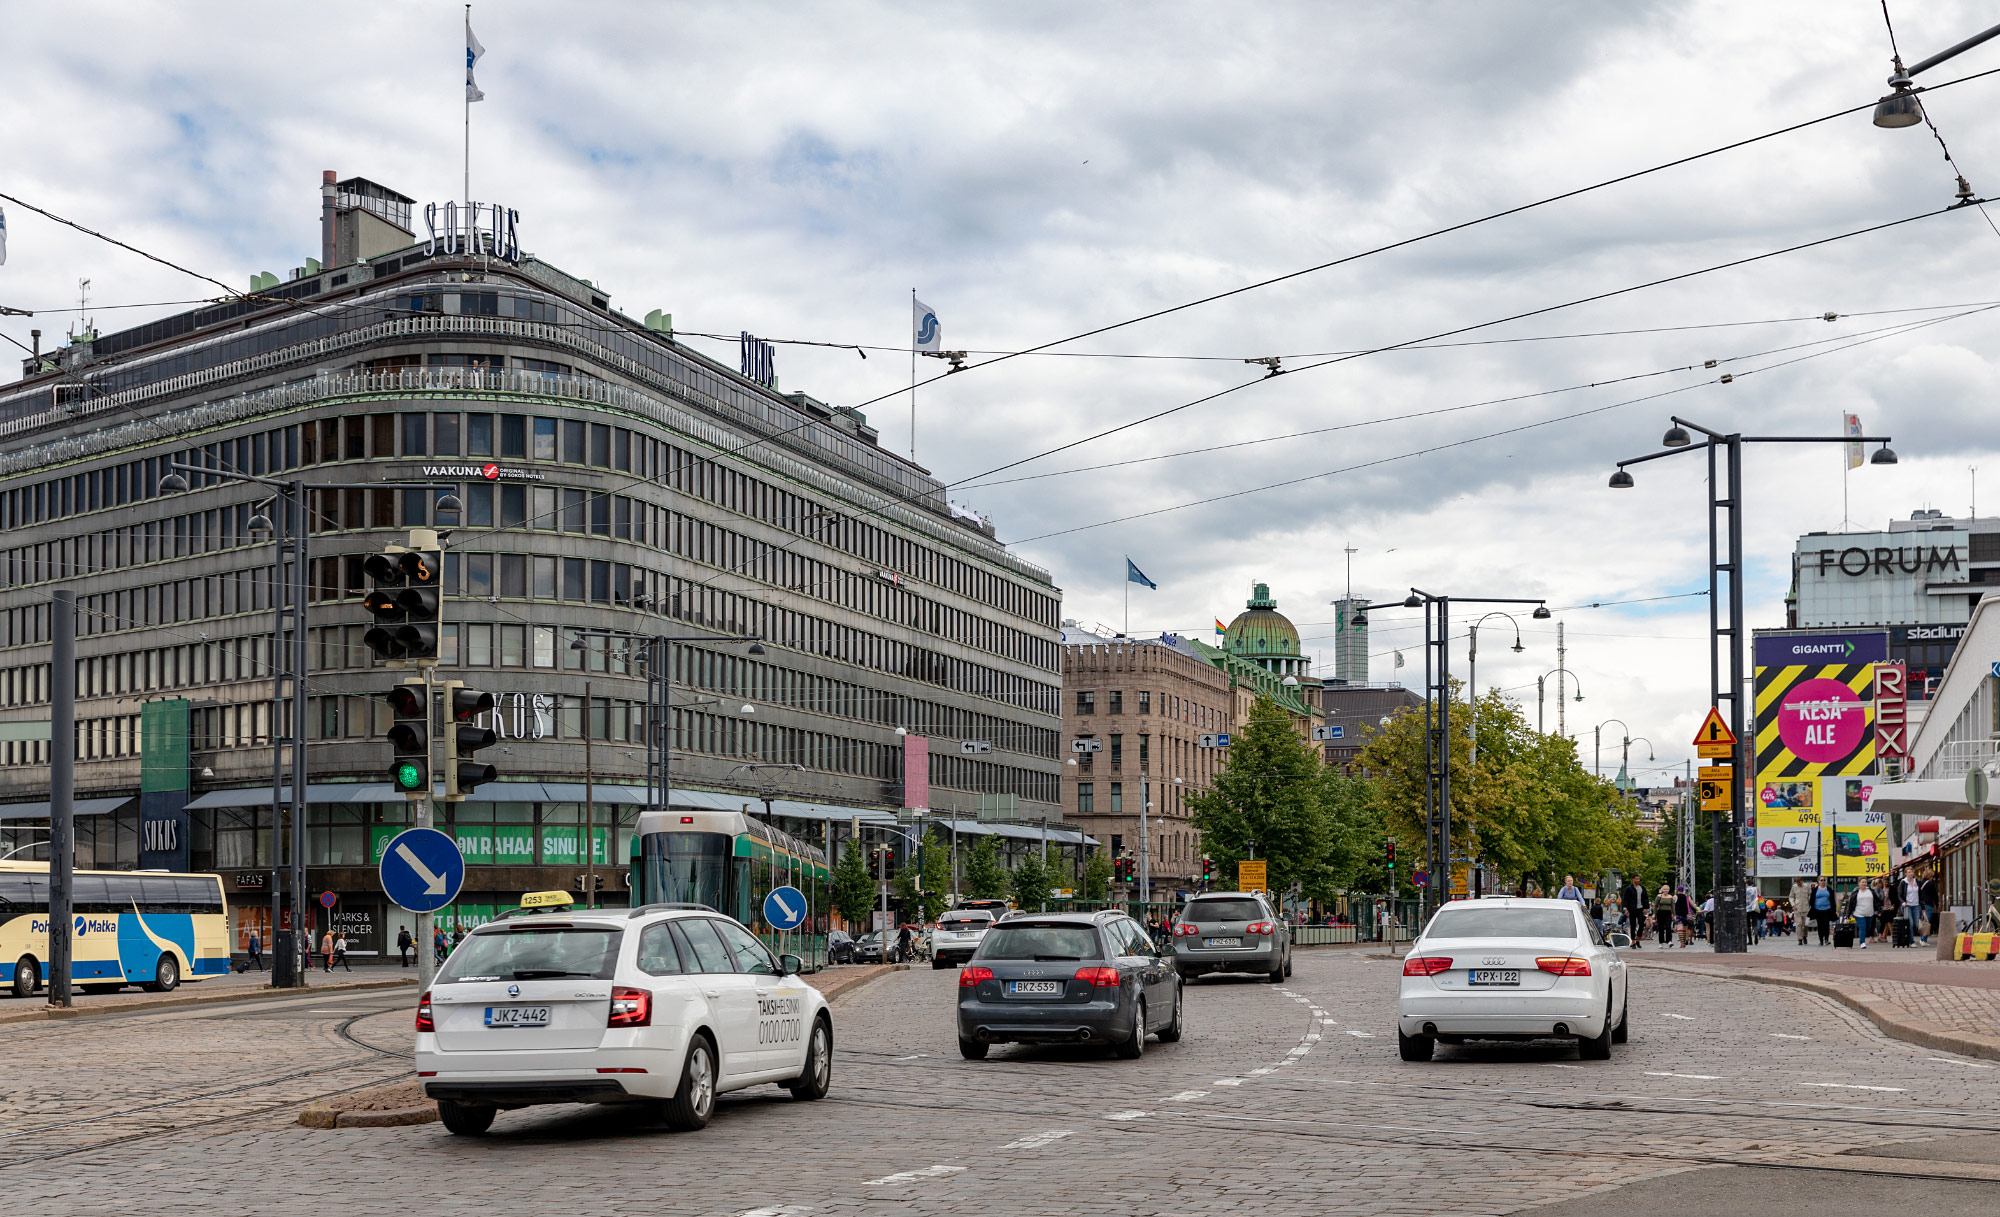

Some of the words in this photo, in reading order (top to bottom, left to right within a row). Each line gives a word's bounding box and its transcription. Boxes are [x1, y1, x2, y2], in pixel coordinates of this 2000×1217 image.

[423, 200, 521, 262] SOKOS
[741, 331, 775, 388] SOKOS
[423, 466, 482, 476] VAAKUNA
[1820, 544, 1960, 577] FORUM
[1792, 644, 1845, 655] GIGANTTI
[477, 693, 544, 739] KOS
[1800, 696, 1848, 720] KESÄ-
[1876, 668, 1904, 754] REX
[1805, 724, 1836, 745] ALE
[1798, 813, 1821, 824] 499€
[1865, 812, 1886, 824] 249€
[144, 819, 177, 852] SOKOS
[481, 836, 534, 855] RAHAA
[1865, 862, 1886, 873] 399€
[236, 875, 263, 885] FAFA'S
[524, 896, 542, 904] 1253
[333, 912, 363, 922] MARKS
[363, 912, 370, 922] &
[88, 920, 116, 933] Matka
[1017, 982, 1055, 992] BKZ-539
[759, 1020, 781, 1044] 0100
[781, 1018, 800, 1042] 0700
